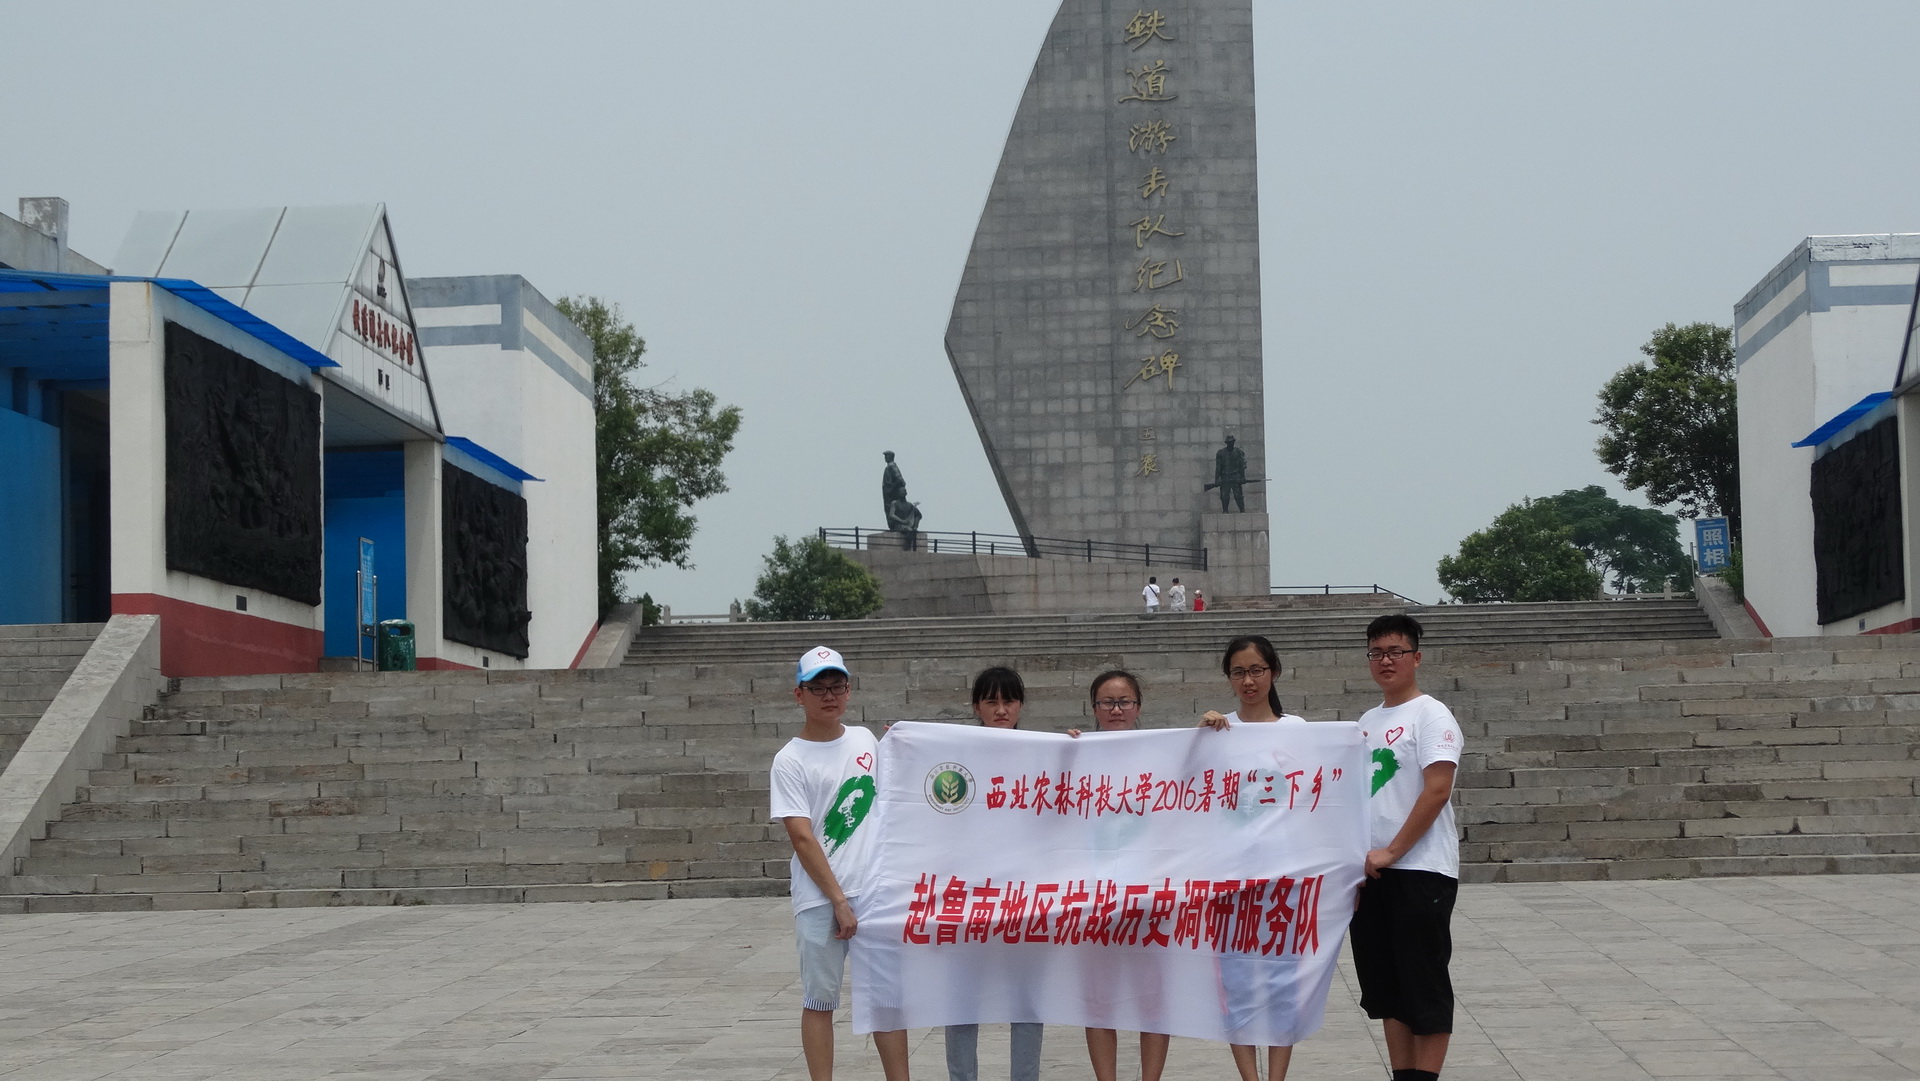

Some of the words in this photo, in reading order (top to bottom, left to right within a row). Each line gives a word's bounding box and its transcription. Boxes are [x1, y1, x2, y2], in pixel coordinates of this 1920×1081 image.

[1702, 528, 1725, 566] 照相
[903, 872, 1325, 957] 赴鲁南地区抗战历史调研服务队
